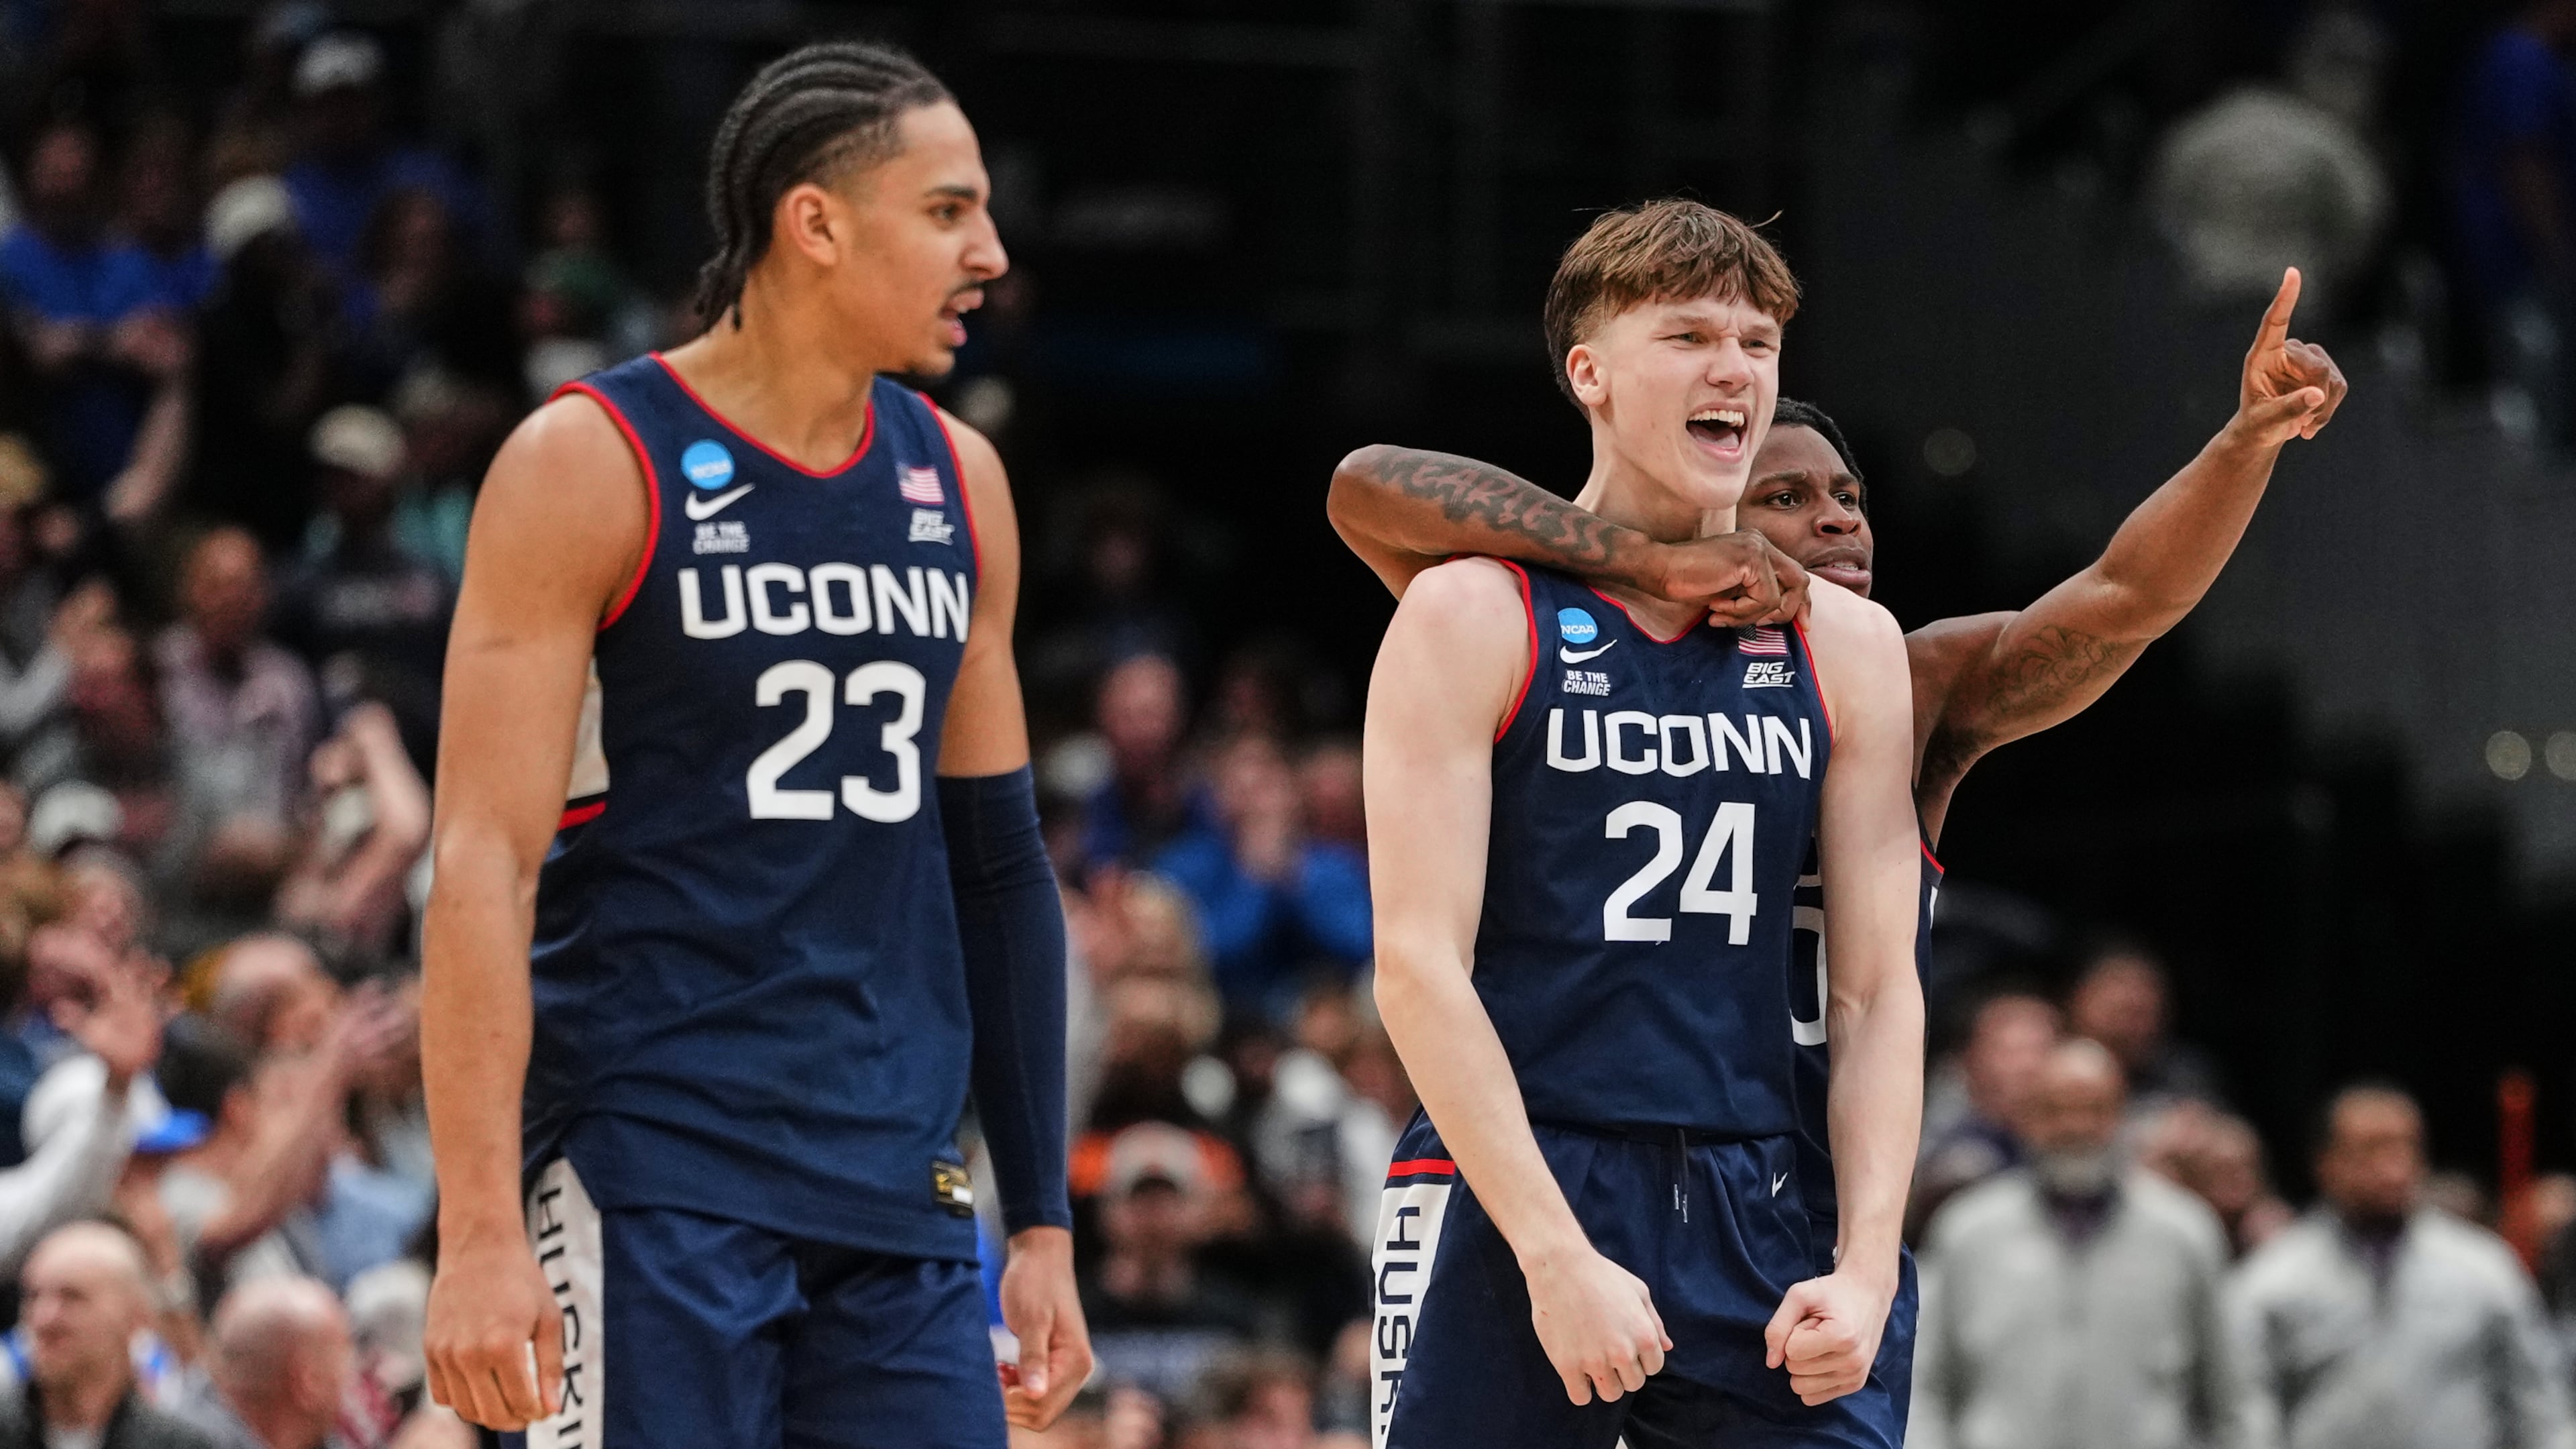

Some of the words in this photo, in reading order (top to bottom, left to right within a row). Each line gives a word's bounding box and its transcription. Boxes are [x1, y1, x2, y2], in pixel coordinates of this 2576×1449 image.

[678, 562, 969, 643] UCONN
[1561, 625, 1595, 635] NCAA
[1563, 680, 1611, 696] CHANGE
[1566, 670, 1583, 681] BE
[1585, 672, 1609, 683] THE
[1743, 671, 1796, 684] EAST
[1747, 661, 1785, 674] BIG
[746, 659, 926, 823] 23
[1547, 708, 1811, 780] UCONN
[1603, 801, 1758, 946] 24
[1379, 1206, 1420, 1435] HUSK
